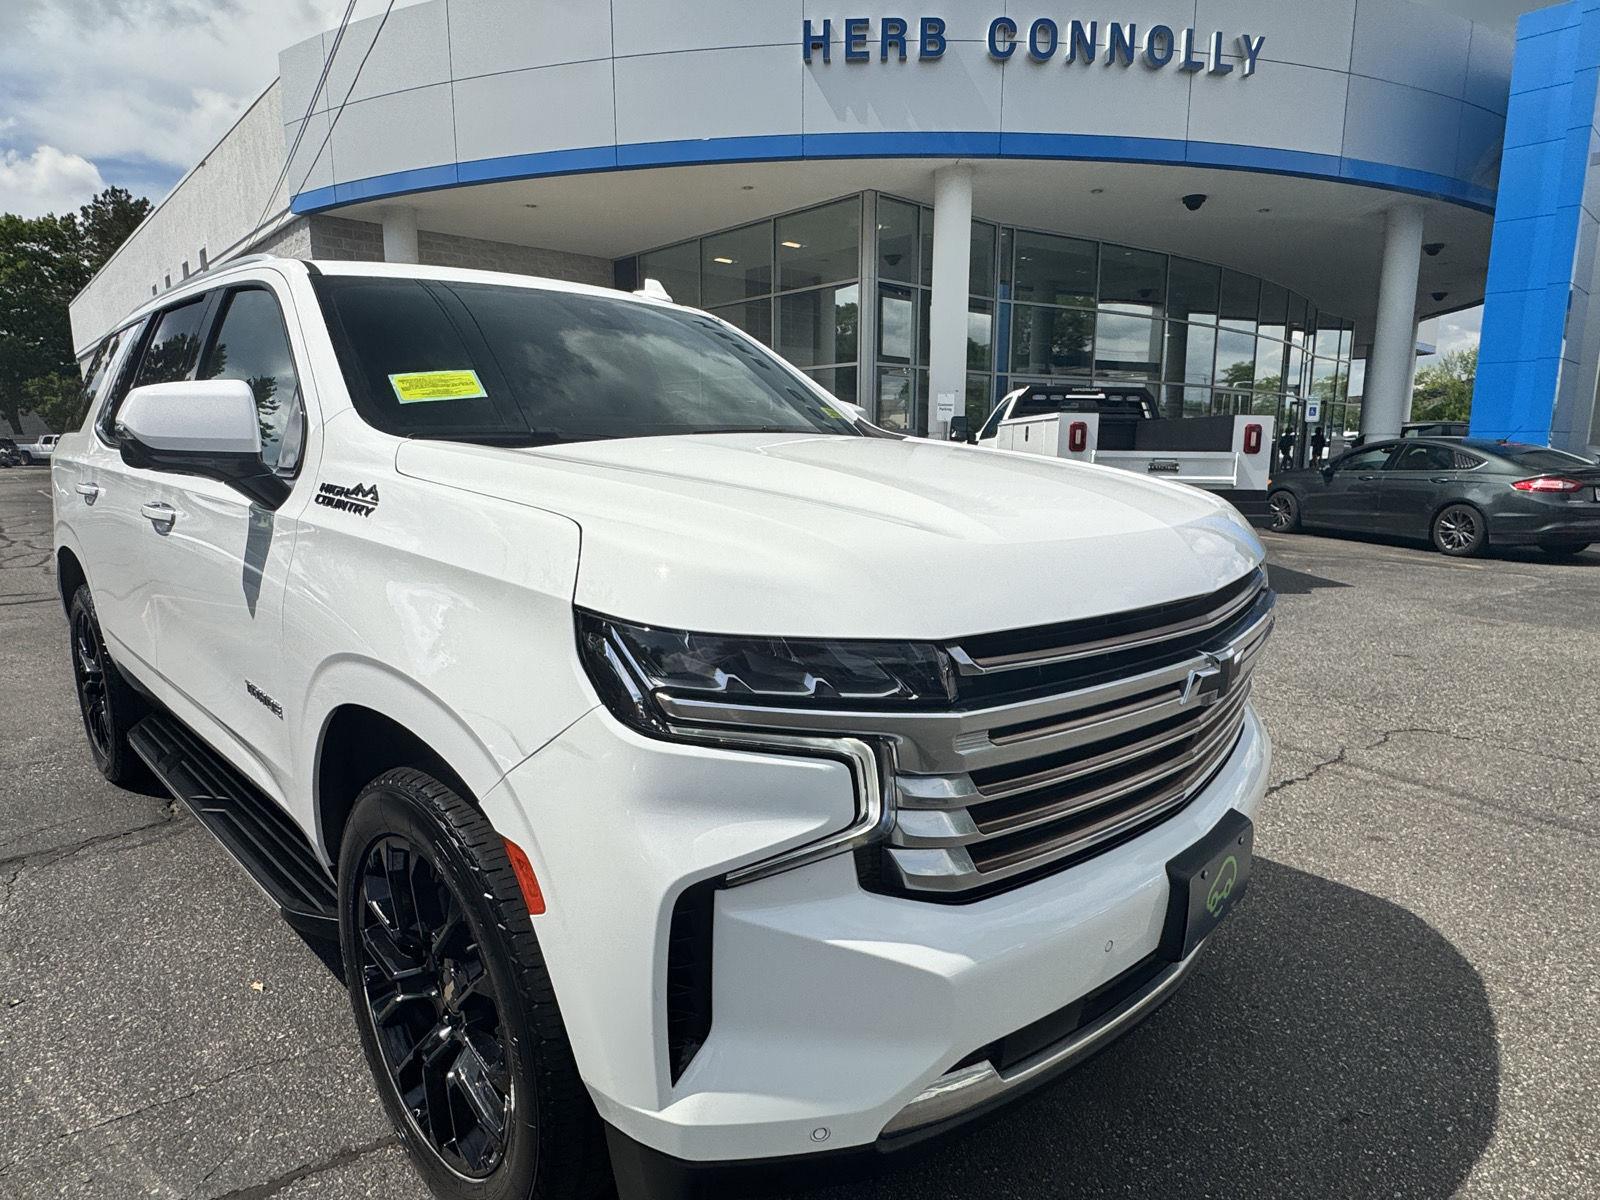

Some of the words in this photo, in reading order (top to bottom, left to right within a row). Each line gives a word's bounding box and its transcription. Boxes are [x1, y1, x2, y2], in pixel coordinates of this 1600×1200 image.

[803, 17, 947, 63] HERB
[987, 16, 1266, 78] CONNOLLY
[319, 482, 350, 498] HIGH
[314, 493, 376, 518] COUNTRY
